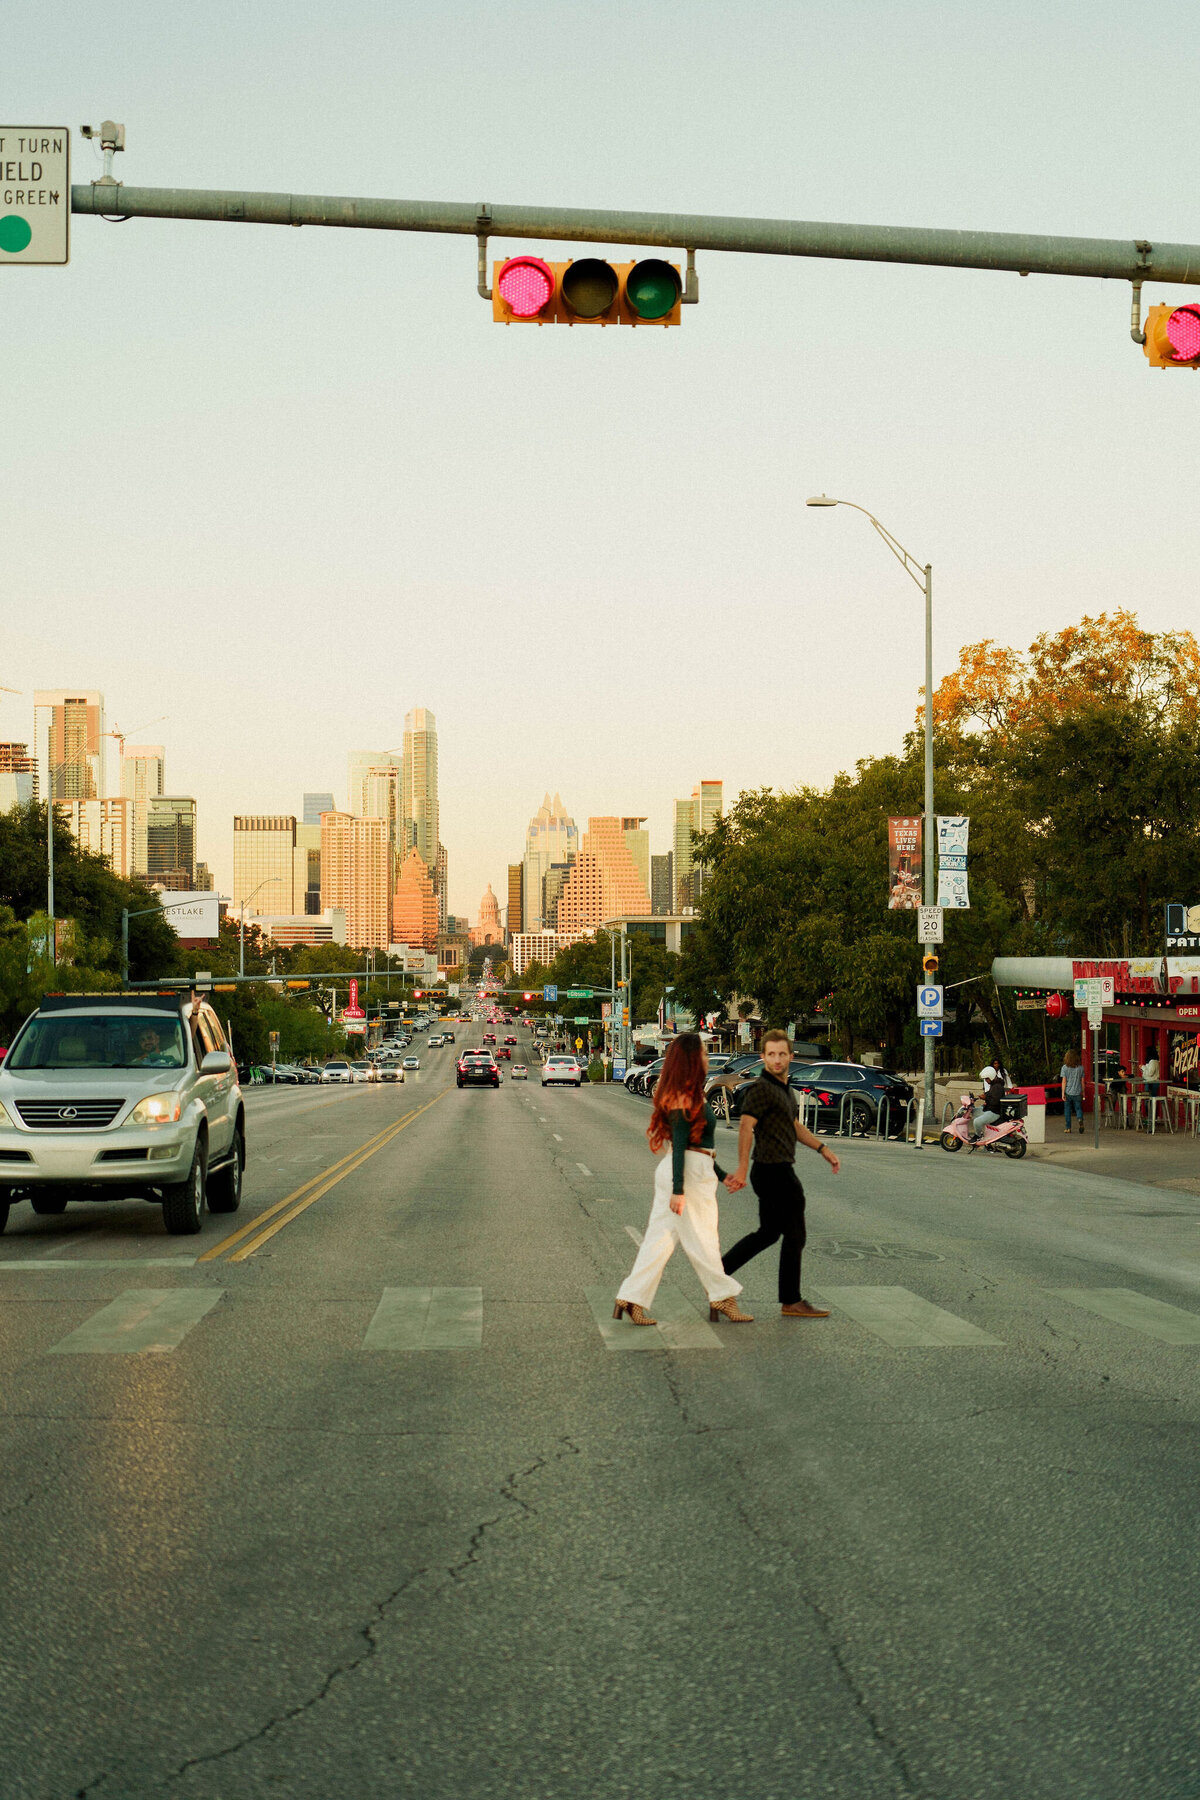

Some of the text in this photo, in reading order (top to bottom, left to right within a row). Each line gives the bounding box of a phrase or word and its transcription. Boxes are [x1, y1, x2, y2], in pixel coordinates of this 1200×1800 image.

[18, 138, 62, 153] TURN
[4, 190, 59, 205] GREEN
[923, 921, 938, 931] 20
[1178, 1007, 1198, 1016] OPEN
[1173, 1045, 1199, 1078] PIZZA
